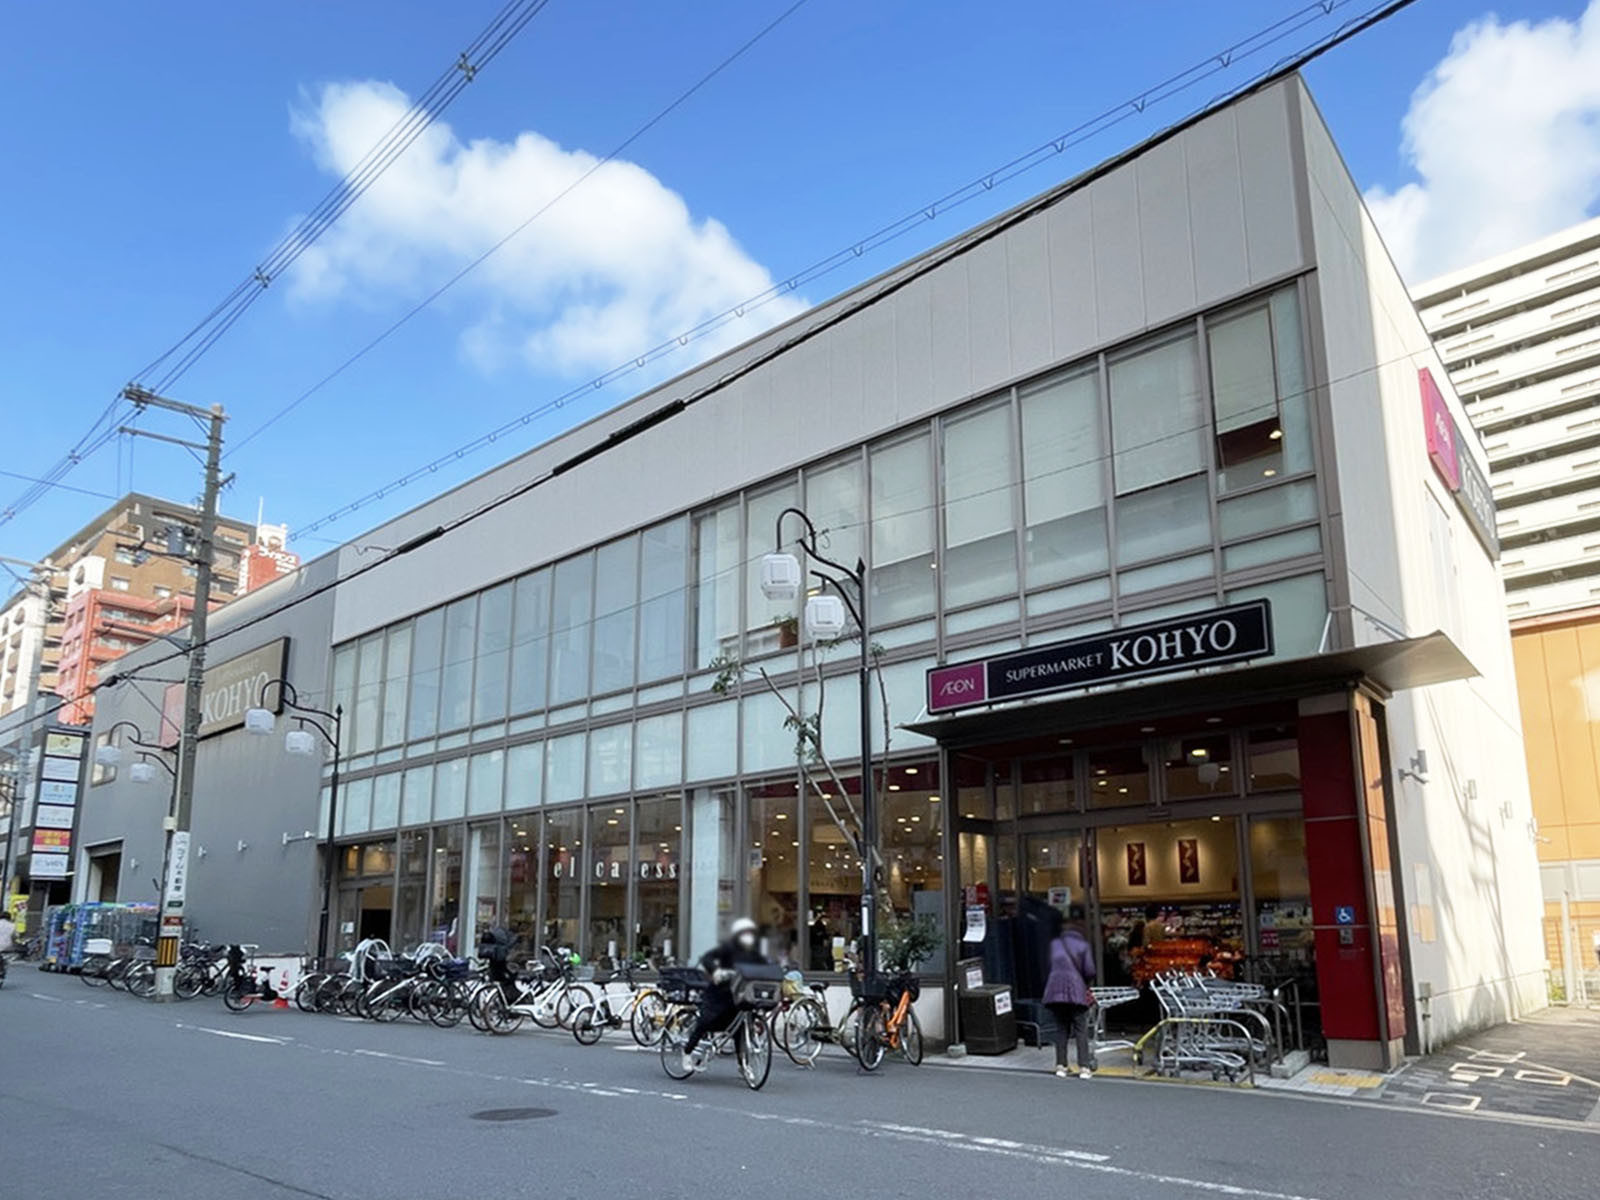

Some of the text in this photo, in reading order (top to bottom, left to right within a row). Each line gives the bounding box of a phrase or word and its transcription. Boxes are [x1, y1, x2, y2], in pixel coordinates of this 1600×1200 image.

[1006, 620, 1237, 682] SUPERMARKET KOHYO
[202, 672, 270, 725] KOHYO
